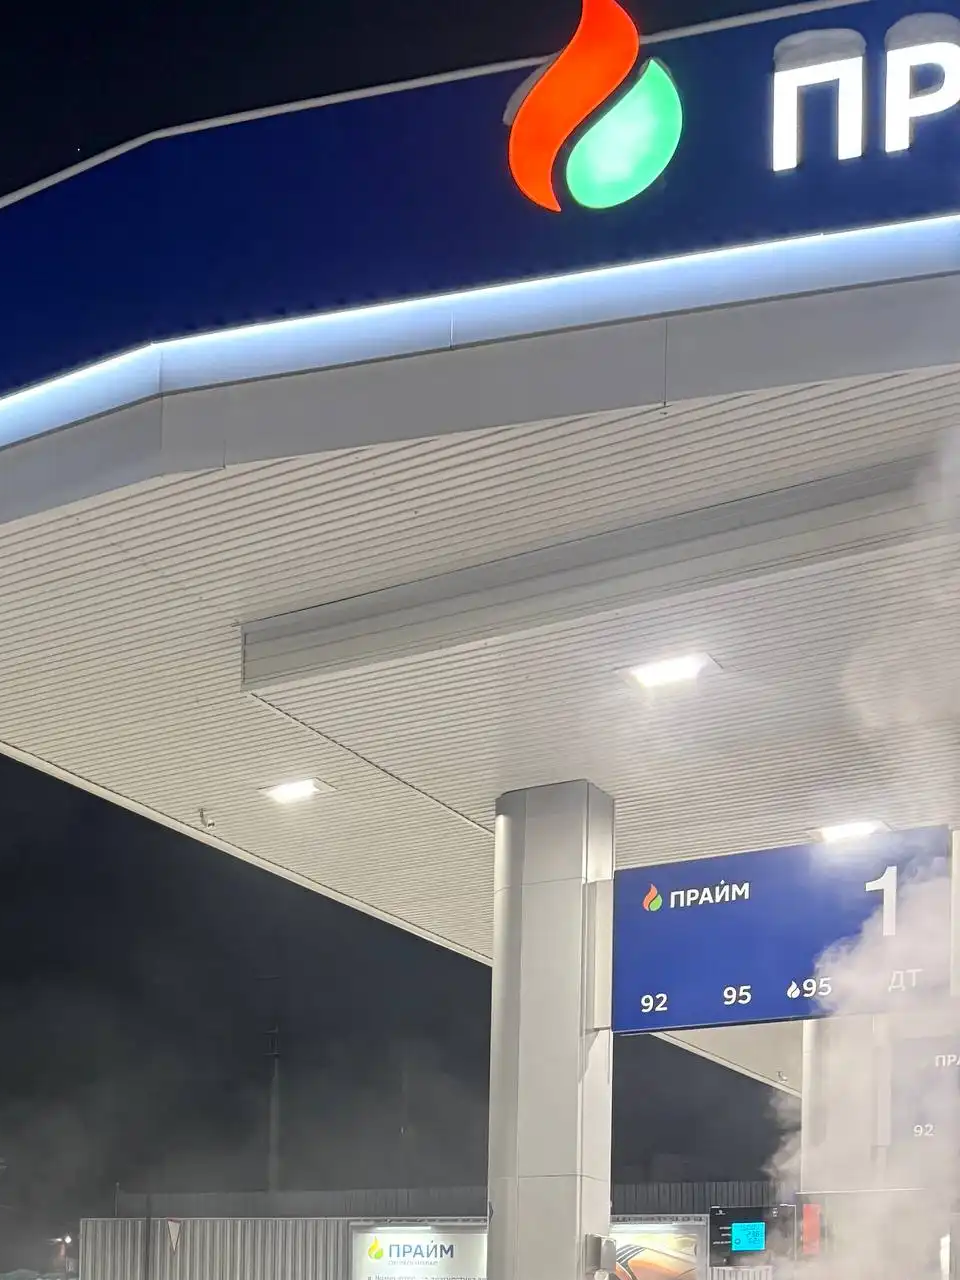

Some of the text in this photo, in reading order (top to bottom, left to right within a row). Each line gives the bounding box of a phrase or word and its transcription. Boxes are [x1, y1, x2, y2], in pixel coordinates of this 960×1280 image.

[773, 41, 960, 172] ПР
[669, 879, 750, 908] ПРАЙМ
[865, 866, 897, 936] 1
[640, 968, 924, 1013] 92 95 95 ДТ
[913, 1123, 935, 1137] 92
[388, 1240, 454, 1259] ПРАЙМ
